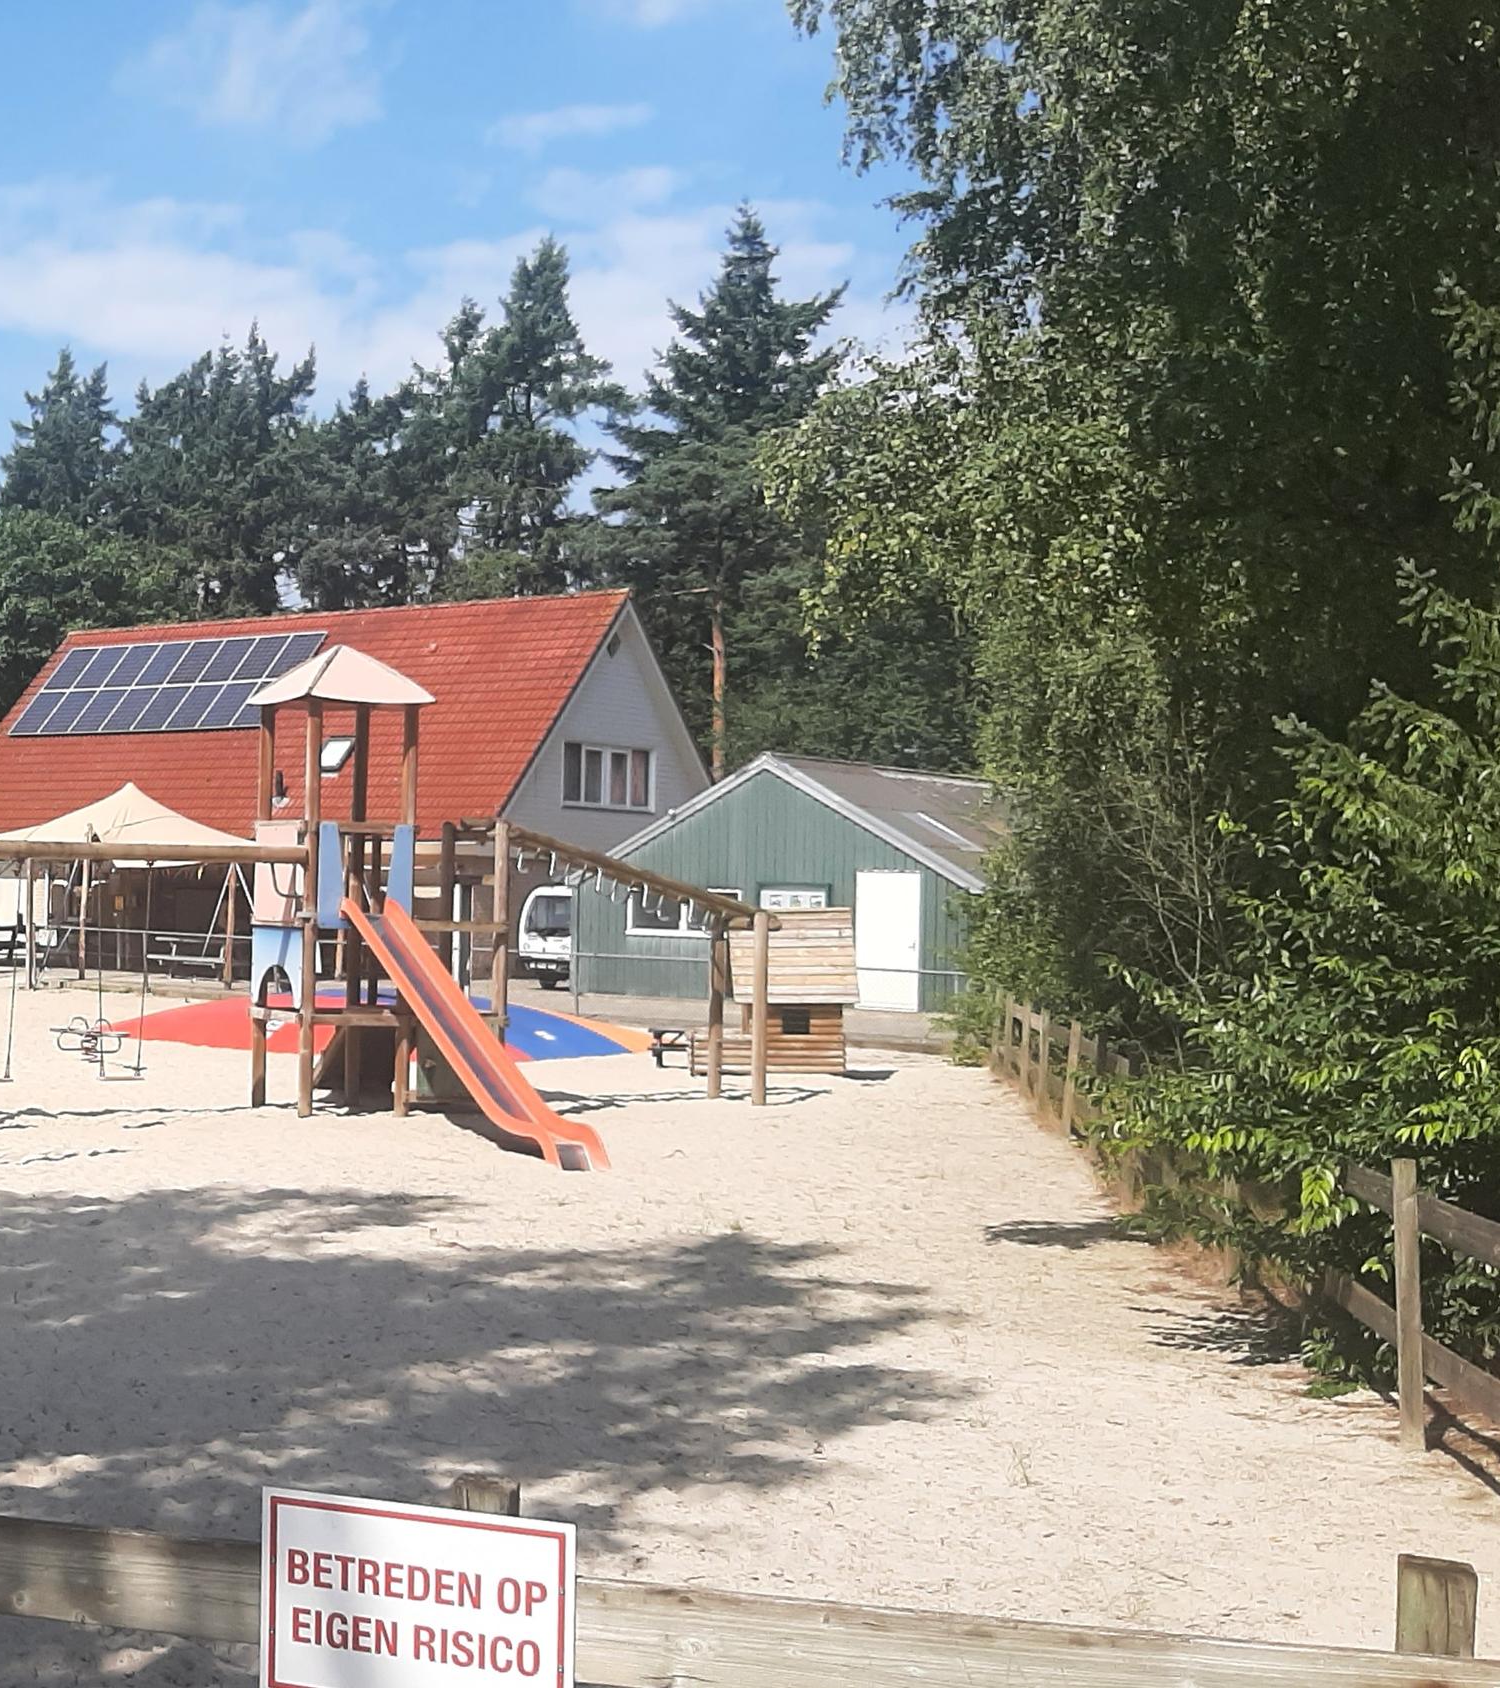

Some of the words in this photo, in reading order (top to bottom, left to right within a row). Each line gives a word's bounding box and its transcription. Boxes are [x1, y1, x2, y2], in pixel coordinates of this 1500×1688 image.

[287, 1548, 482, 1609] BETREDEN
[497, 1577, 548, 1617] OP
[291, 1606, 398, 1657] EIGEN
[413, 1624, 541, 1677] RISICO
